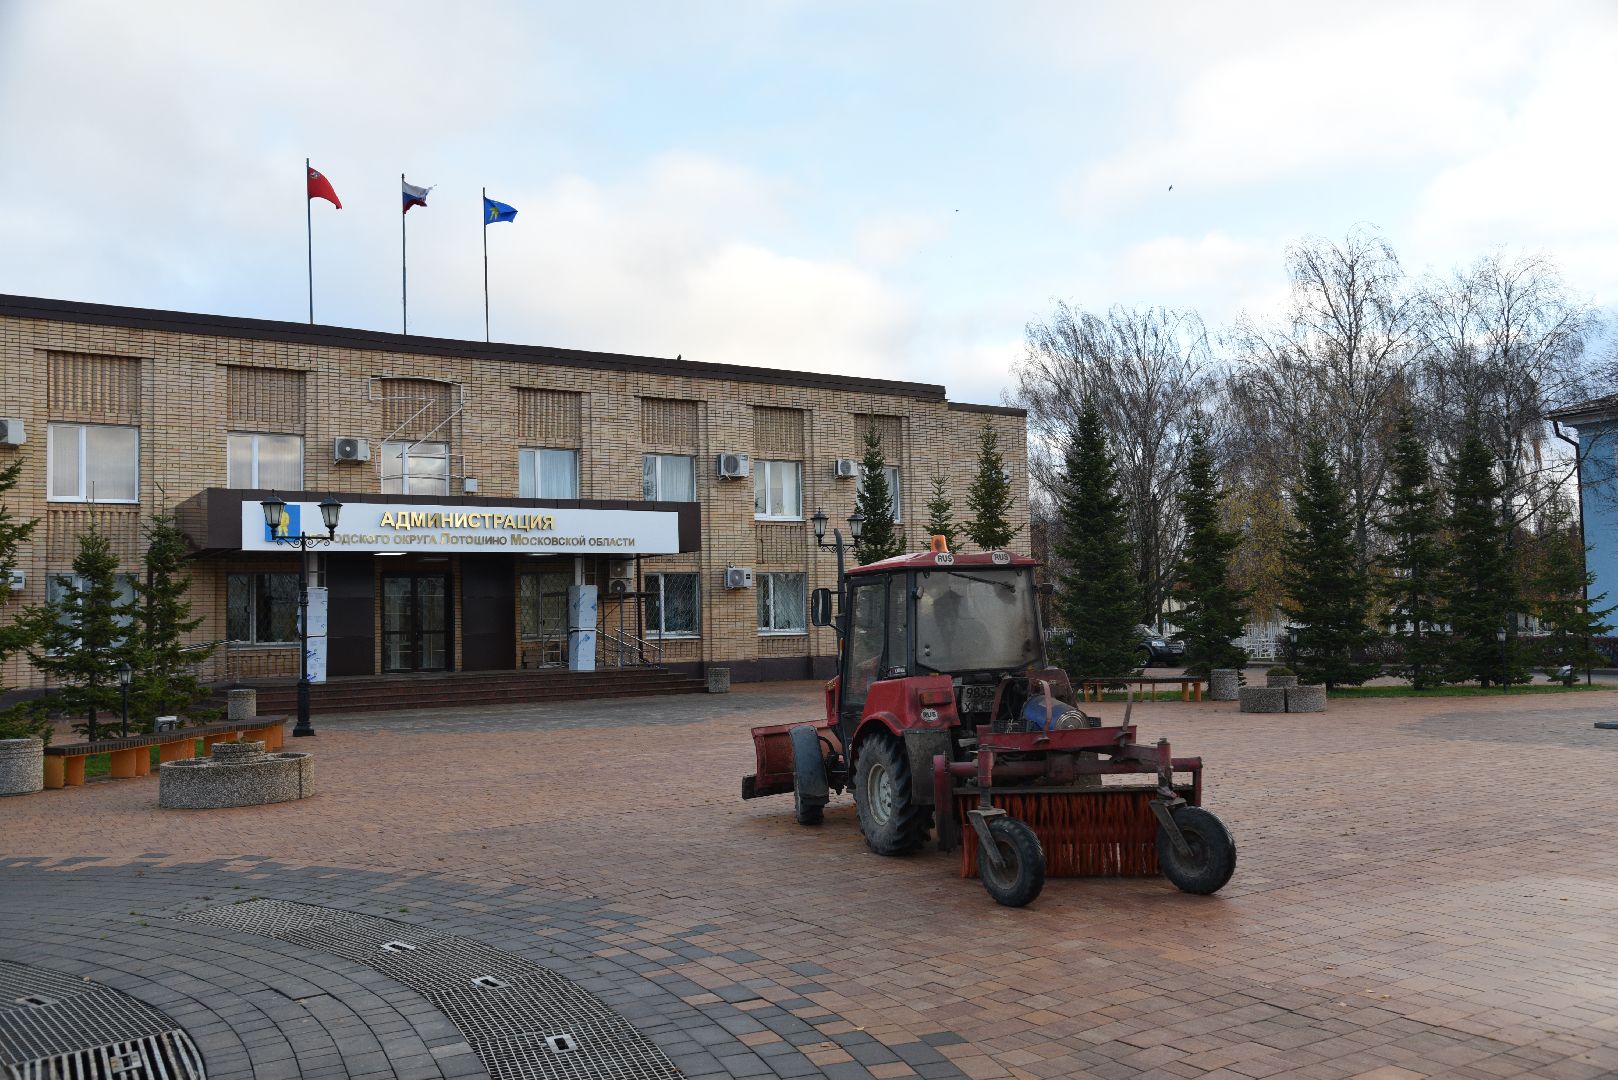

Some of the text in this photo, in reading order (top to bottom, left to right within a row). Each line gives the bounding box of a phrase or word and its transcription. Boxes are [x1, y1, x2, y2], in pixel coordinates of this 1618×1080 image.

[380, 511, 554, 532] АДМИНИСТРАЦИЯ
[393, 534, 437, 545] ОКРУГА
[588, 536, 635, 547] ОБЛАСТИ
[994, 553, 1009, 561] RUS
